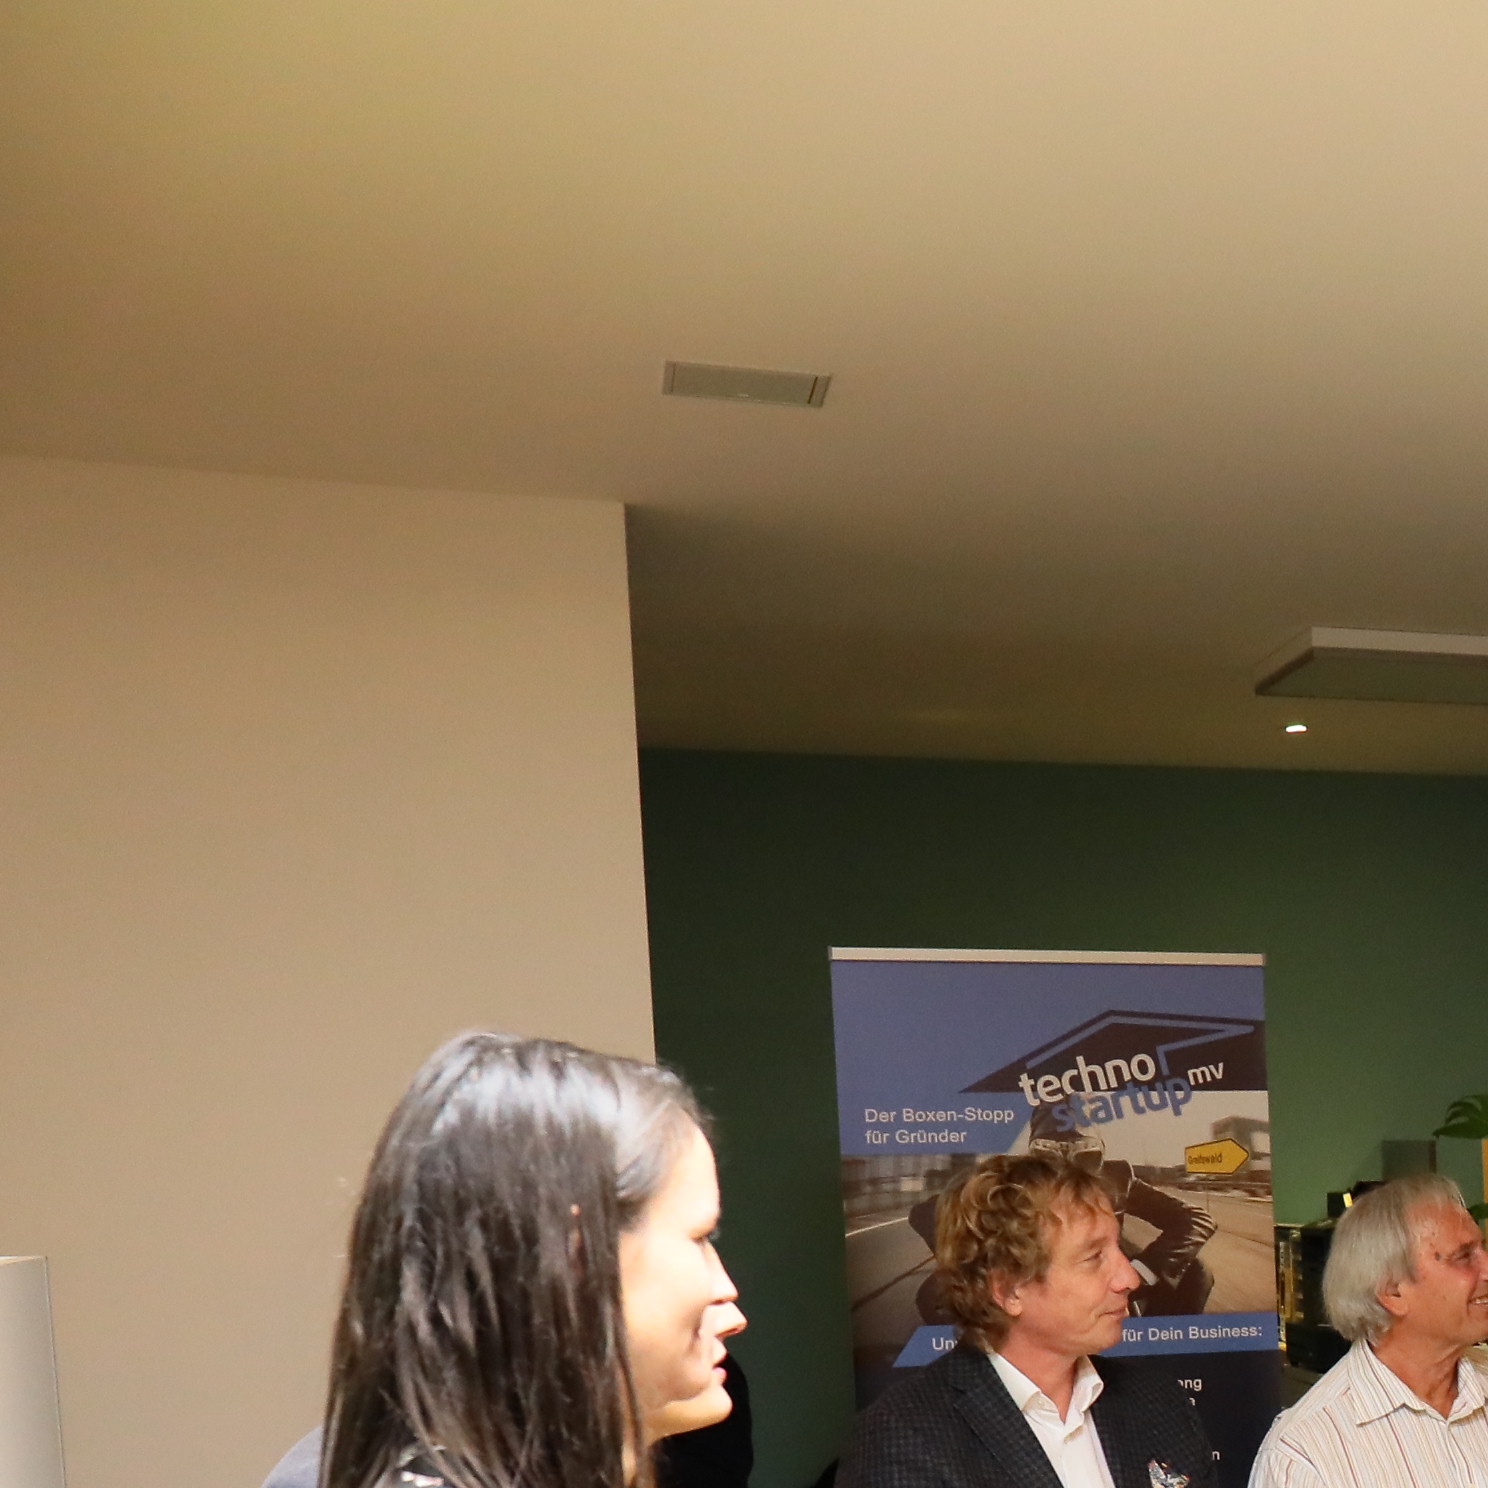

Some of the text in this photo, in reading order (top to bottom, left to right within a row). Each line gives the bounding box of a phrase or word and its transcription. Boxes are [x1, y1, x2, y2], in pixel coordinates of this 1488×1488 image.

[1019, 1053, 1225, 1107] techno mv
[1053, 1077, 1193, 1132] startup
[864, 1107, 1015, 1124] Der Boxen-Stopp
[865, 1129, 968, 1144] für Gründer
[1121, 1328, 1143, 1342] für
[1148, 1327, 1183, 1341] Dein
[1188, 1325, 1262, 1340] Business:
